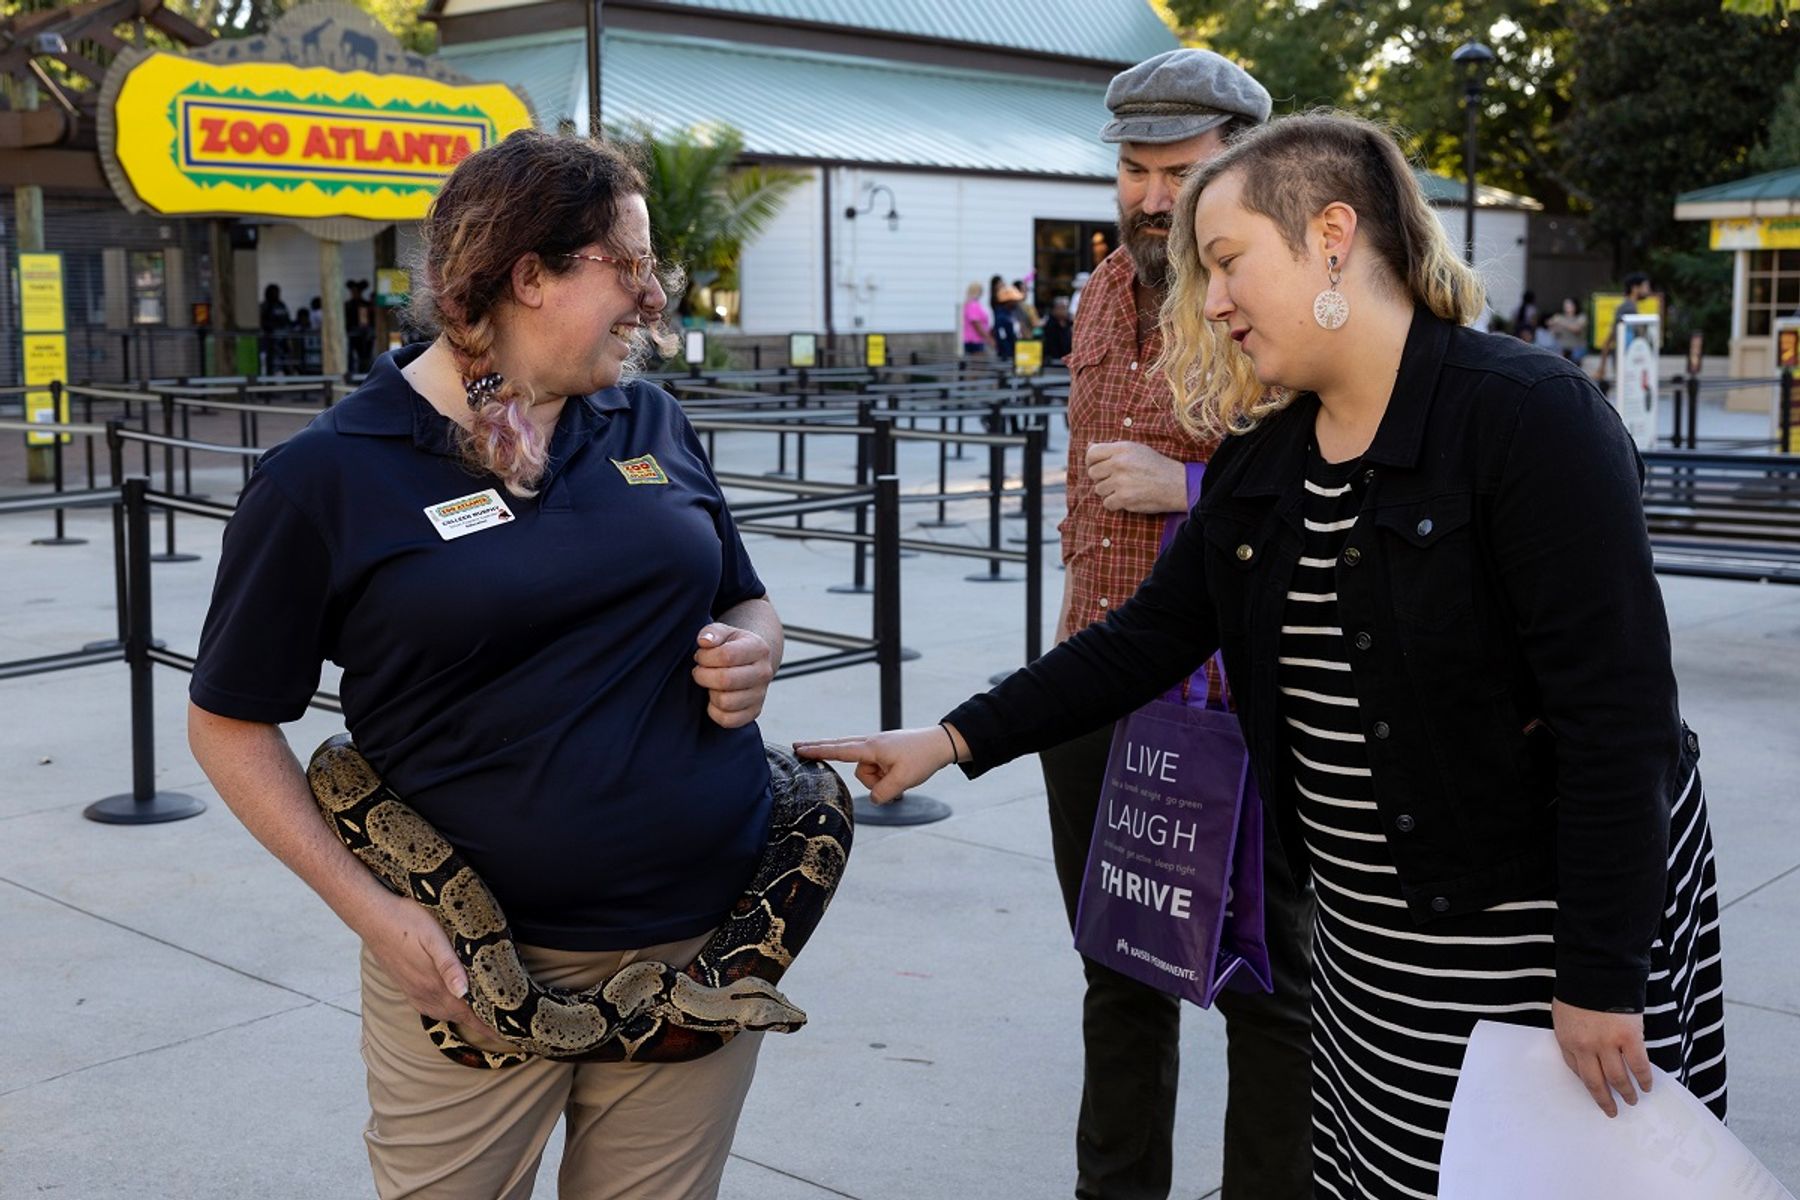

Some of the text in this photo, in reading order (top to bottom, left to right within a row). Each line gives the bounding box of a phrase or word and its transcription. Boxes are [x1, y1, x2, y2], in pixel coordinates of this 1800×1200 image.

[199, 117, 473, 166] ZOO ATLANTA
[624, 463, 650, 471] ZOO
[1126, 741, 1180, 783] LIVE
[1165, 796, 1177, 806] go
[1178, 799, 1203, 810] green
[1108, 799, 1197, 852] LAUGH
[1154, 859, 1175, 872] sleep
[1176, 863, 1196, 876] tight
[1101, 860, 1193, 920] THRIVE
[1130, 946, 1150, 963] KAISER
